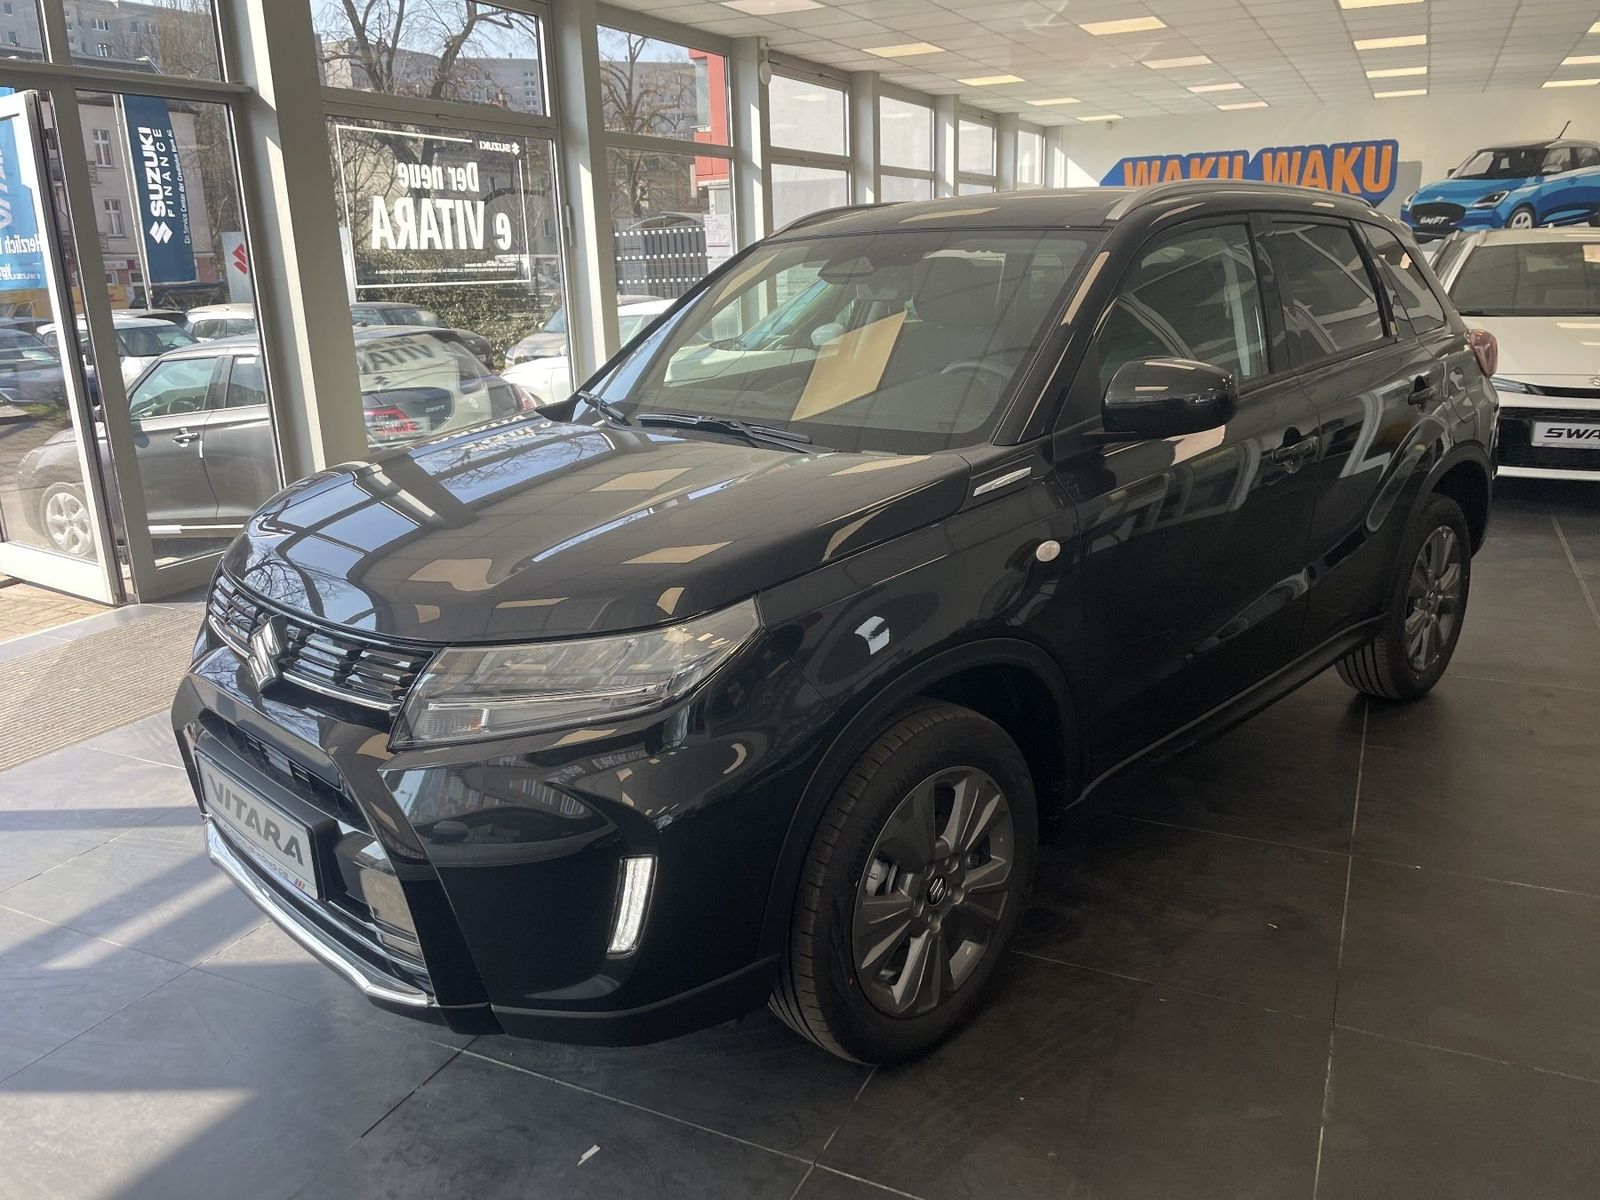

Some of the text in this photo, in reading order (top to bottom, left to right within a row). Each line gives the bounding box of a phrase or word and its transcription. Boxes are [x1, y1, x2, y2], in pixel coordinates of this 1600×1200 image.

[138, 126, 166, 217] SUZUKI
[152, 128, 176, 218] FINANCE
[1123, 145, 1393, 194] WAKU WAKU
[1543, 427, 1600, 440] SWA
[206, 771, 305, 867] VITARA
